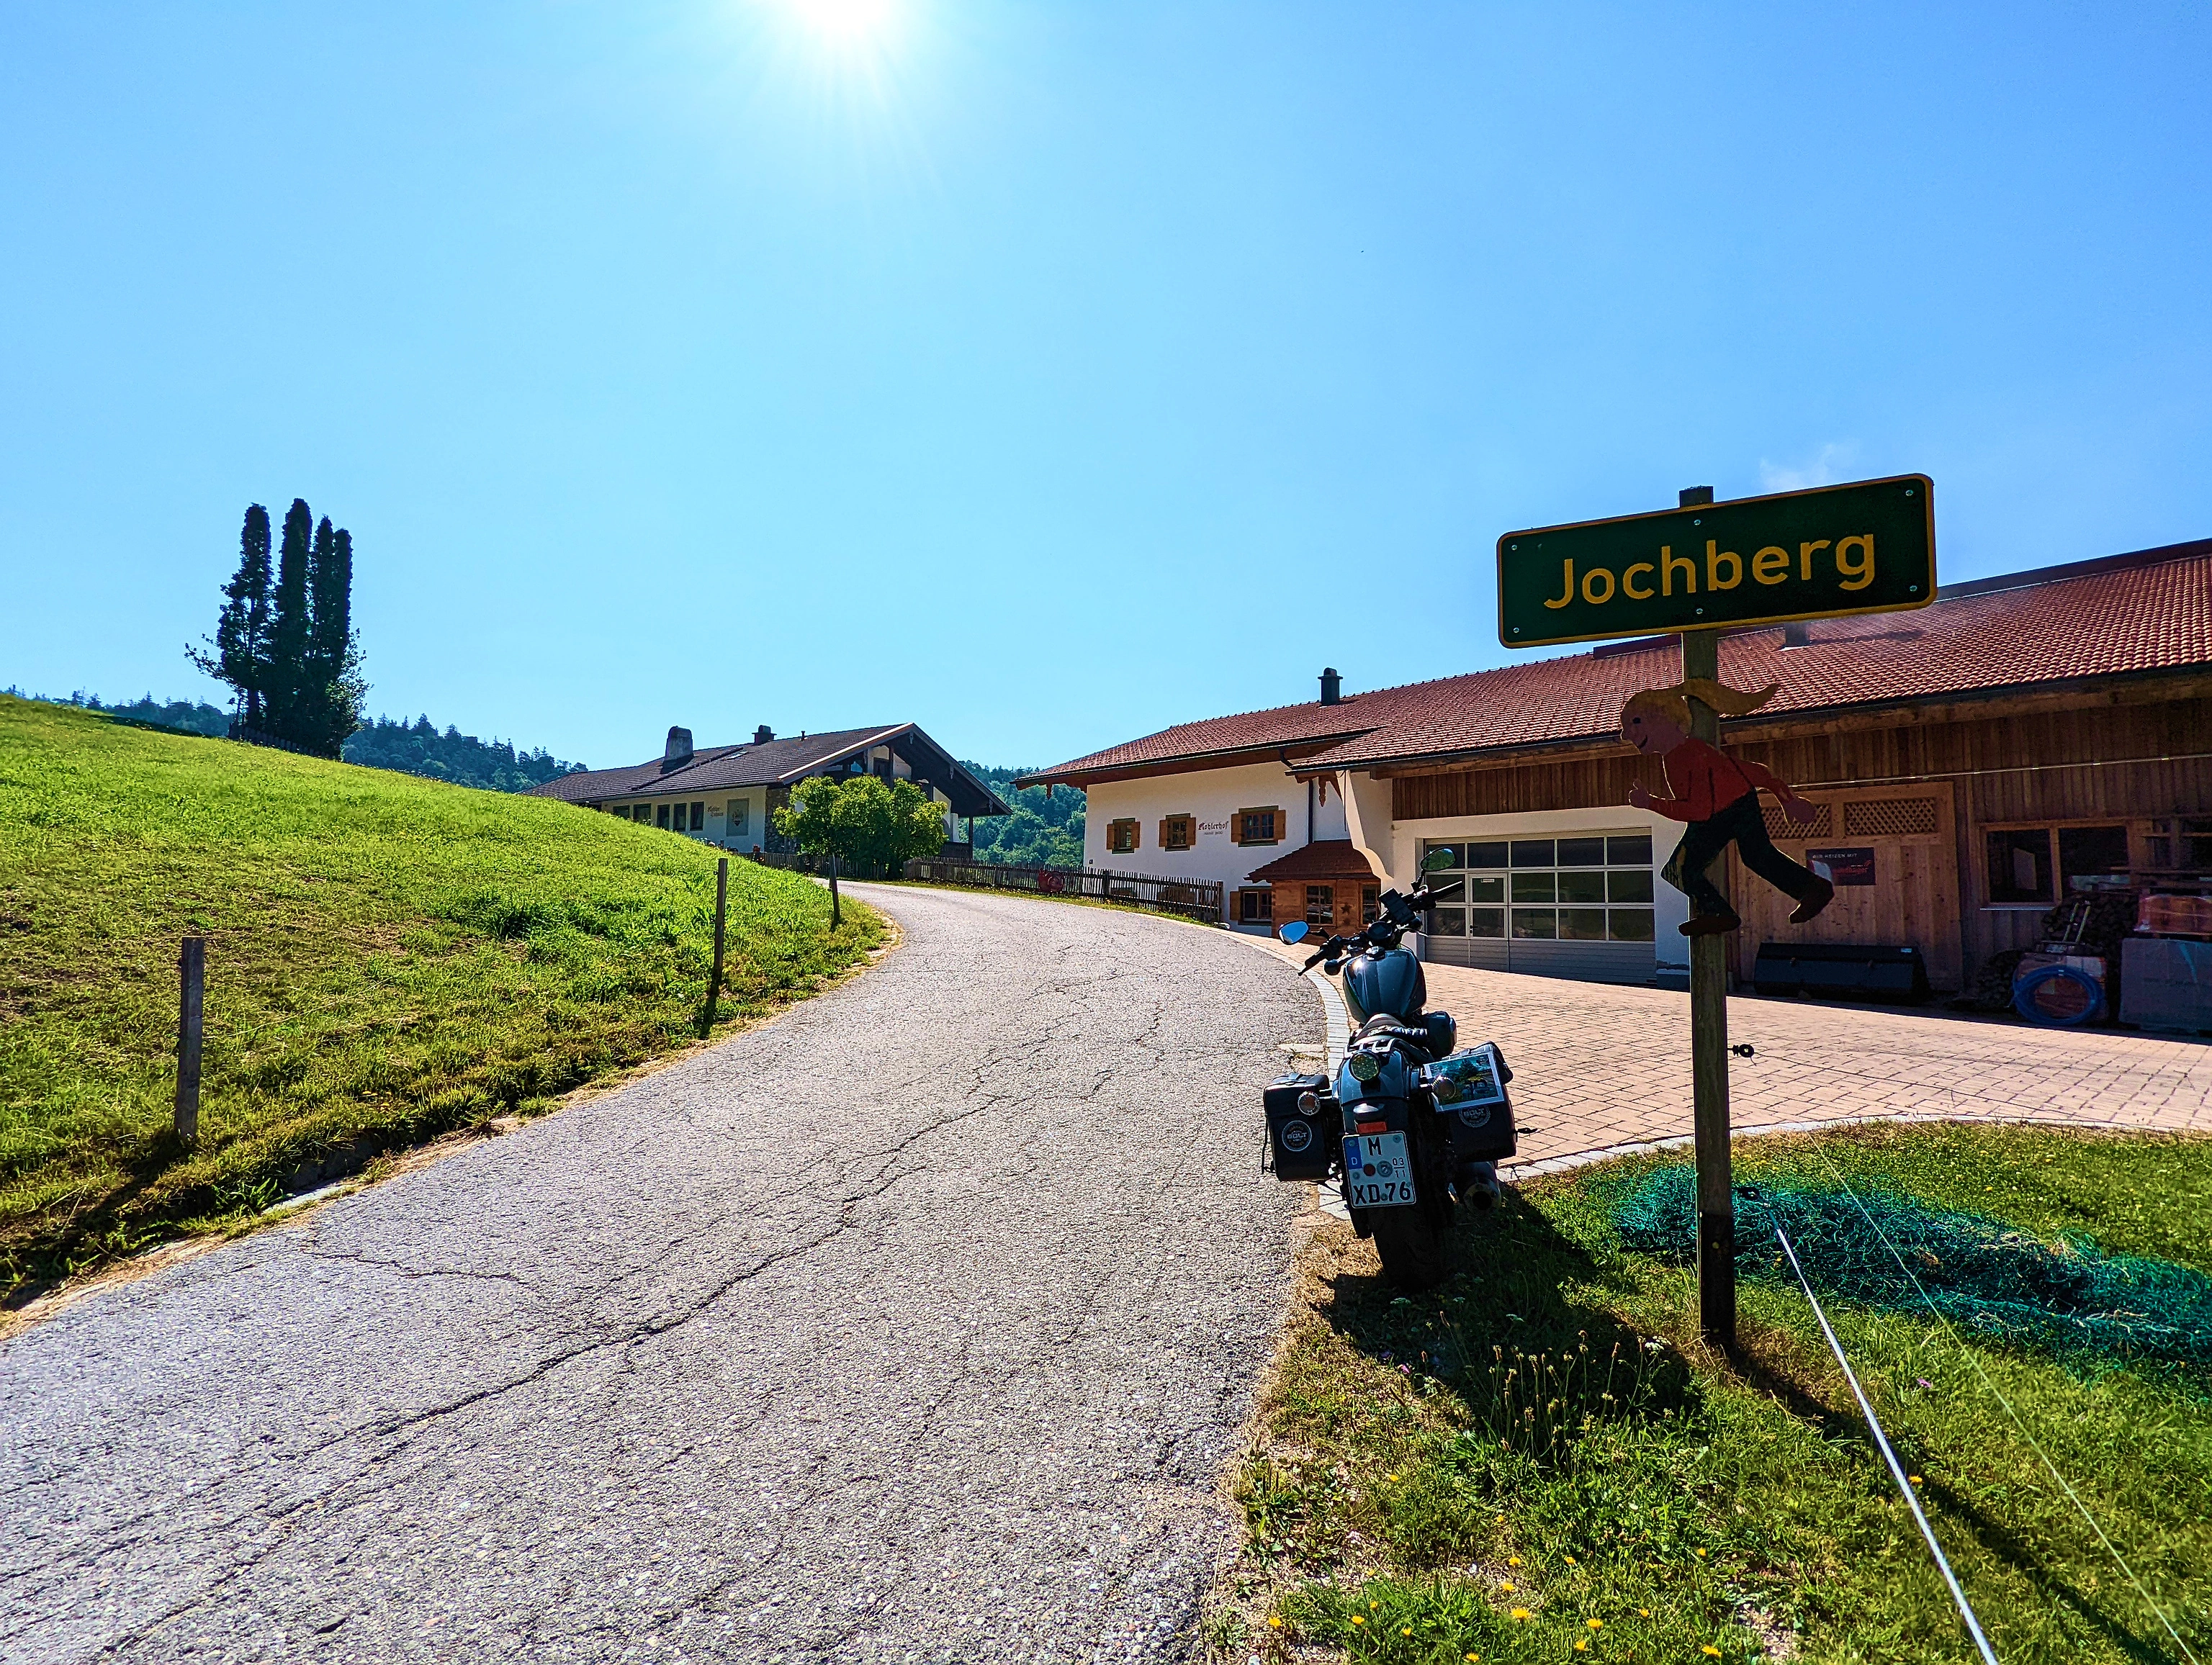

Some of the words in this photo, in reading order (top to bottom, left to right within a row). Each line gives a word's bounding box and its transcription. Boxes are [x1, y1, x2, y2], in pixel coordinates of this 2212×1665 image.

[1542, 533, 1876, 609] Jochberg
[1367, 1137, 1382, 1156] M
[1351, 1157, 1358, 1165] D
[1392, 1157, 1405, 1166] 03
[1395, 1170, 1406, 1178] 11
